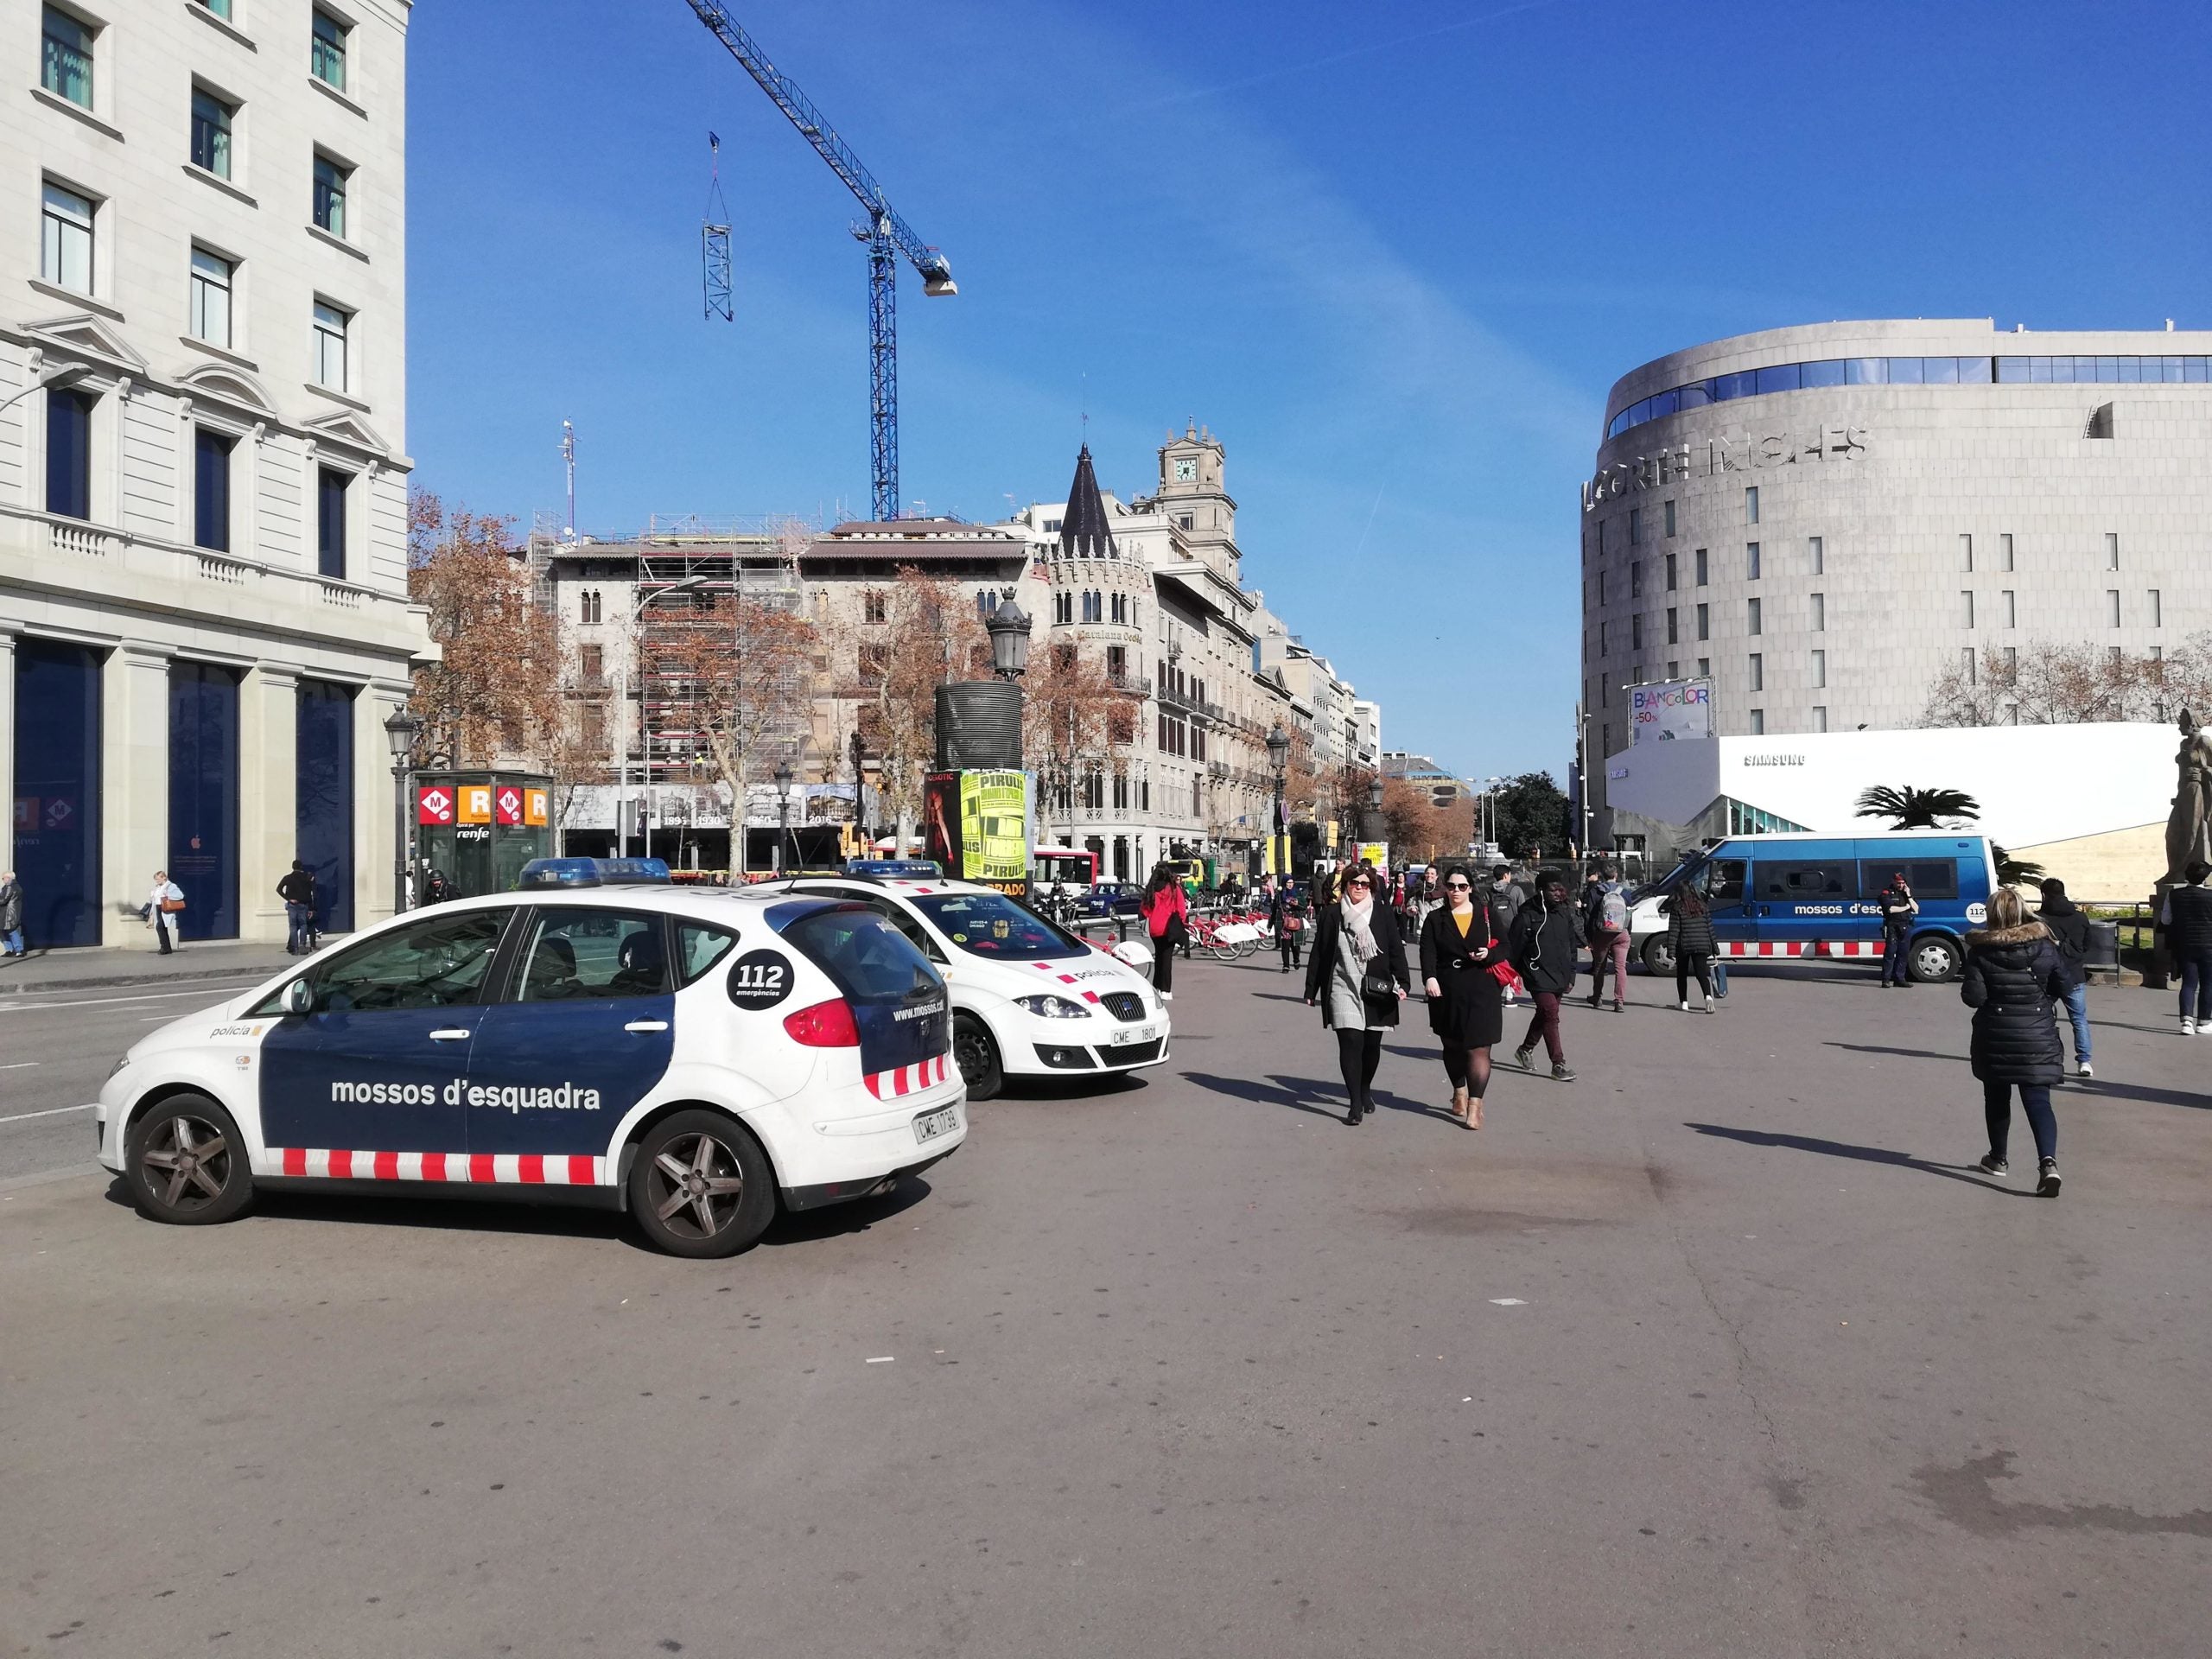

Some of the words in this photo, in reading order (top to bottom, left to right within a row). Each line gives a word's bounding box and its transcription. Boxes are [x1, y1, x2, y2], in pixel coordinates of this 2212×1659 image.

[1744, 754, 1805, 766] SAMSUNG
[430, 797, 442, 808] M
[471, 791, 490, 813] R
[505, 797, 513, 807] M
[533, 794, 547, 816] R
[809, 815, 832, 824] 2016
[457, 826, 489, 842] renfe
[986, 882, 1026, 896] RADO
[1795, 906, 1843, 914] mossos
[1849, 903, 1884, 916] d'esq
[737, 964, 784, 988] 112
[1113, 1031, 1130, 1044] CME
[1141, 1027, 1156, 1040] 1801
[331, 1081, 435, 1105] mossos
[443, 1078, 601, 1114] d'esquadra
[918, 1116, 937, 1139] CME
[937, 1109, 957, 1132] 1739
